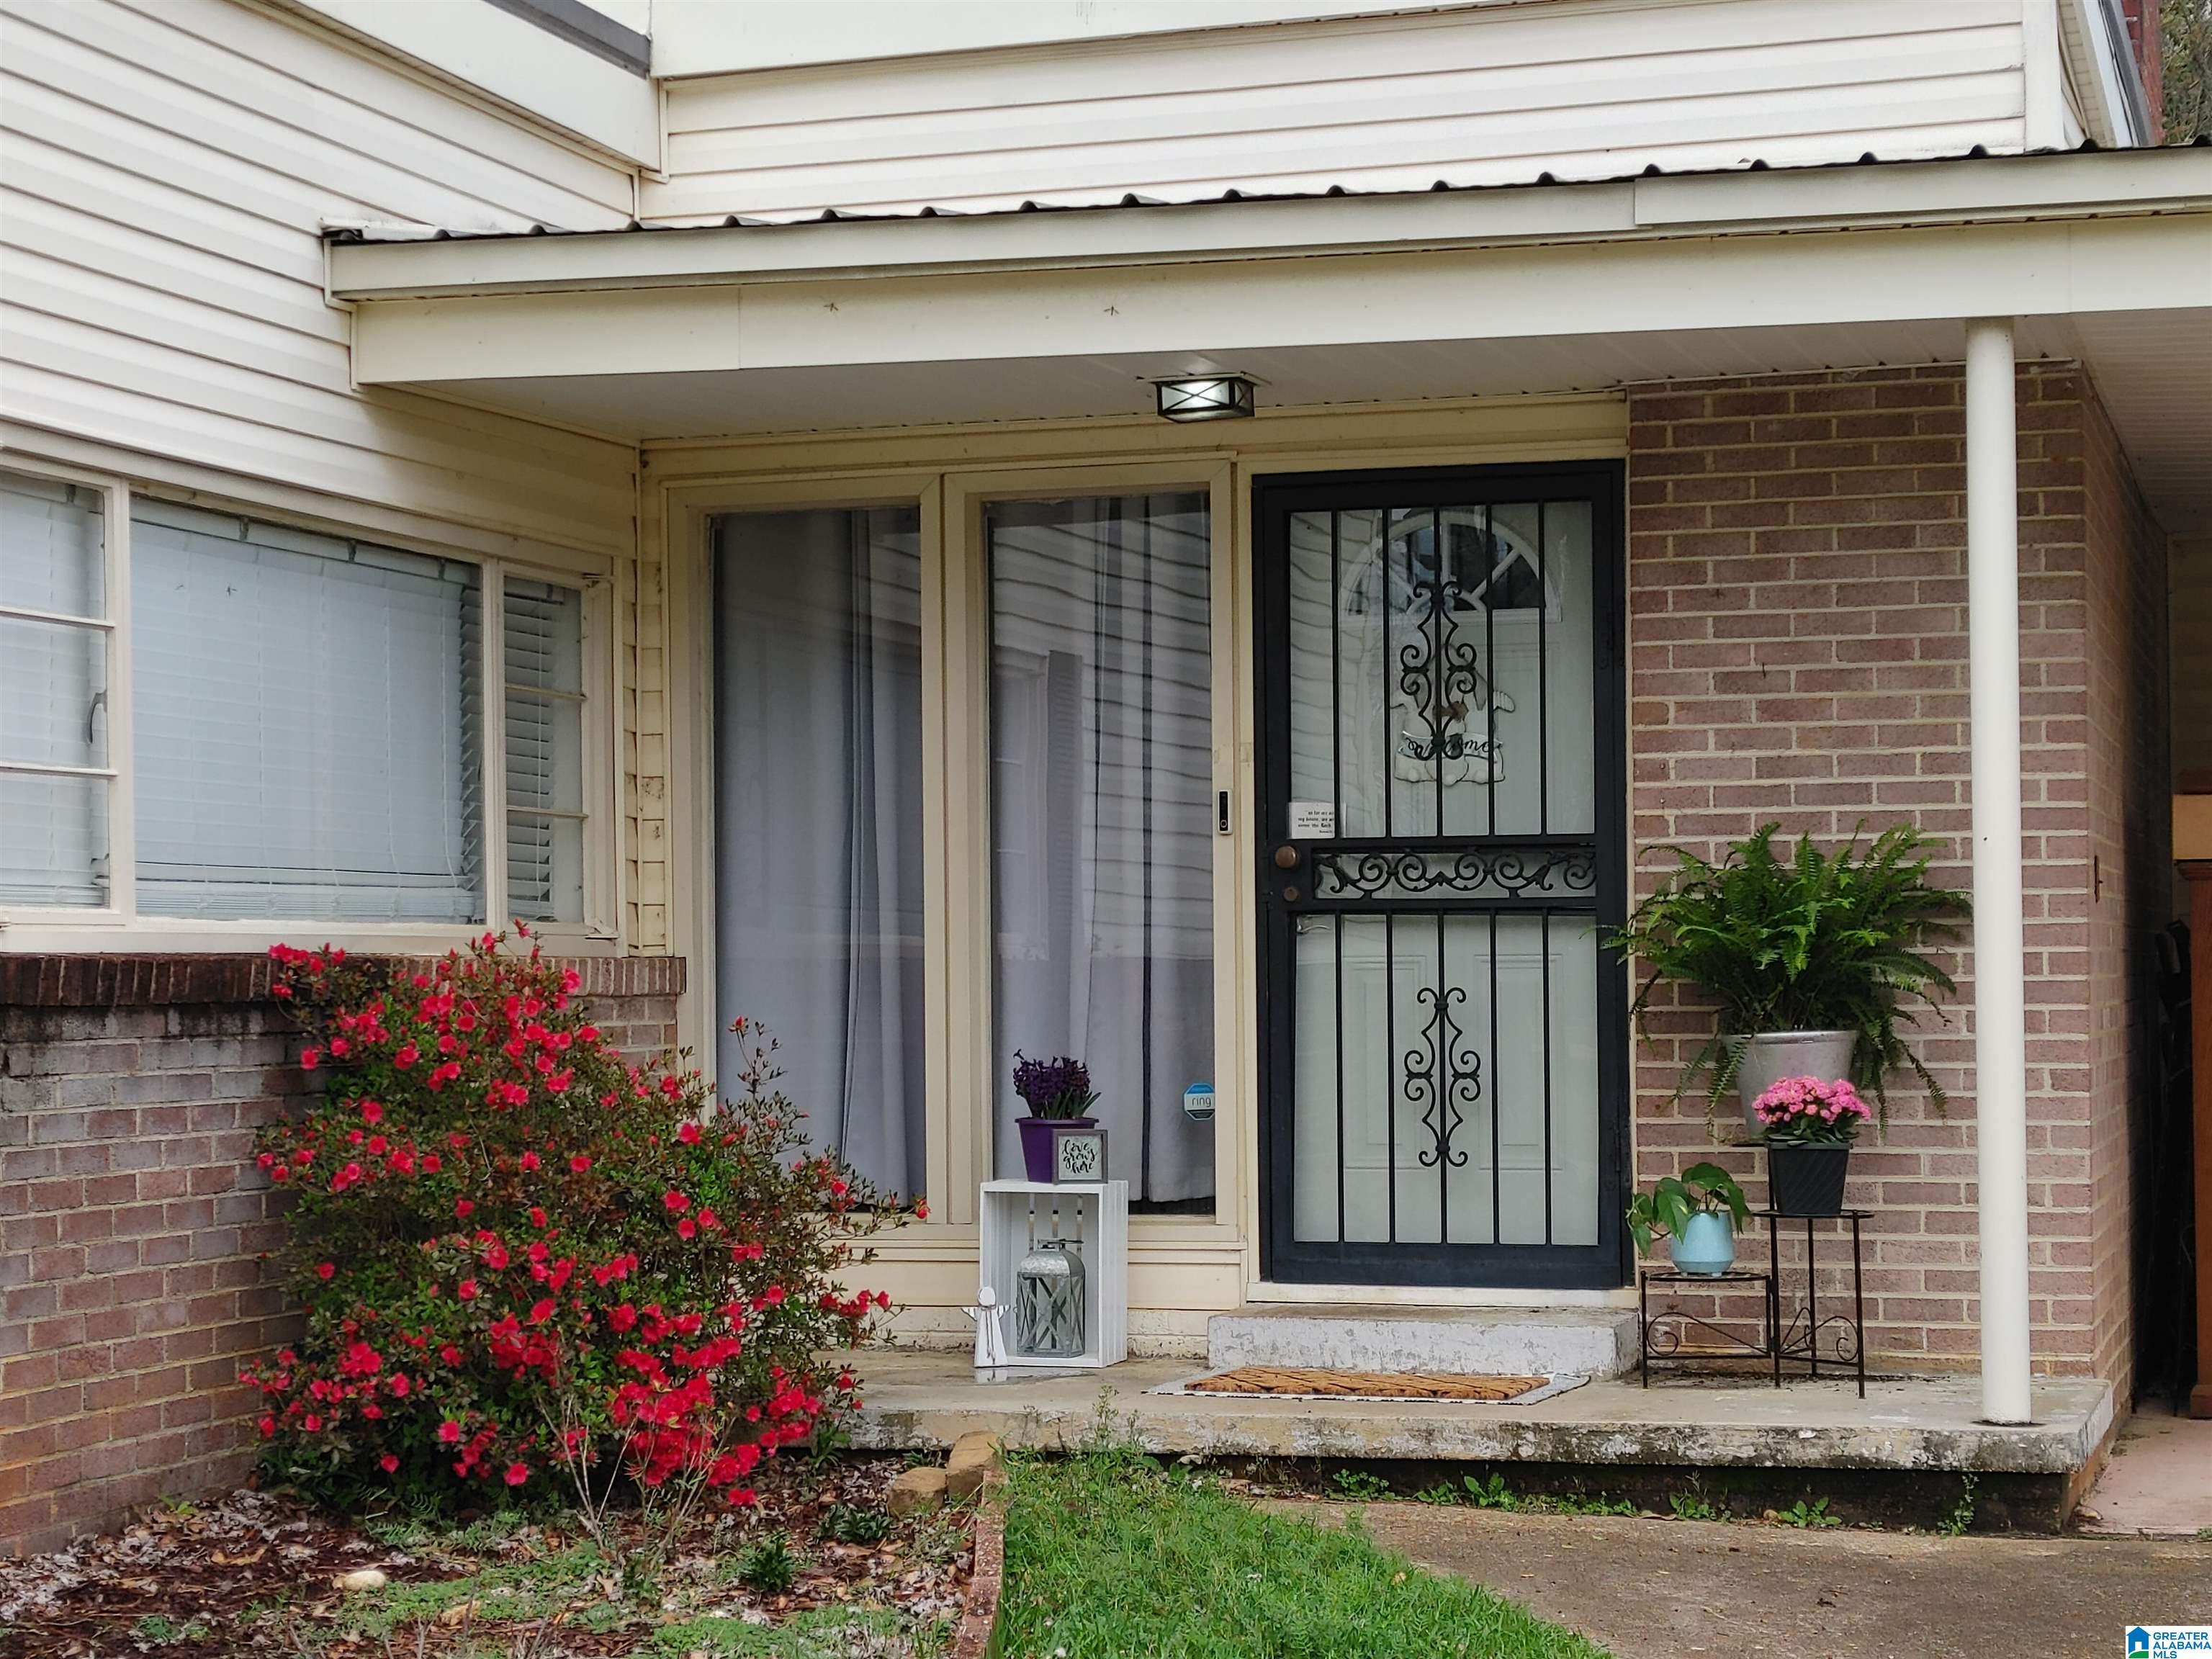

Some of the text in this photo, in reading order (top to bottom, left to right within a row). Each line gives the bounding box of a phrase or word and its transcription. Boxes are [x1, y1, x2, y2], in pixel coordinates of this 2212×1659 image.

[1192, 1097, 1211, 1107] ring
[1063, 1148, 1097, 1169] grows
[1071, 1160, 1094, 1174] here
